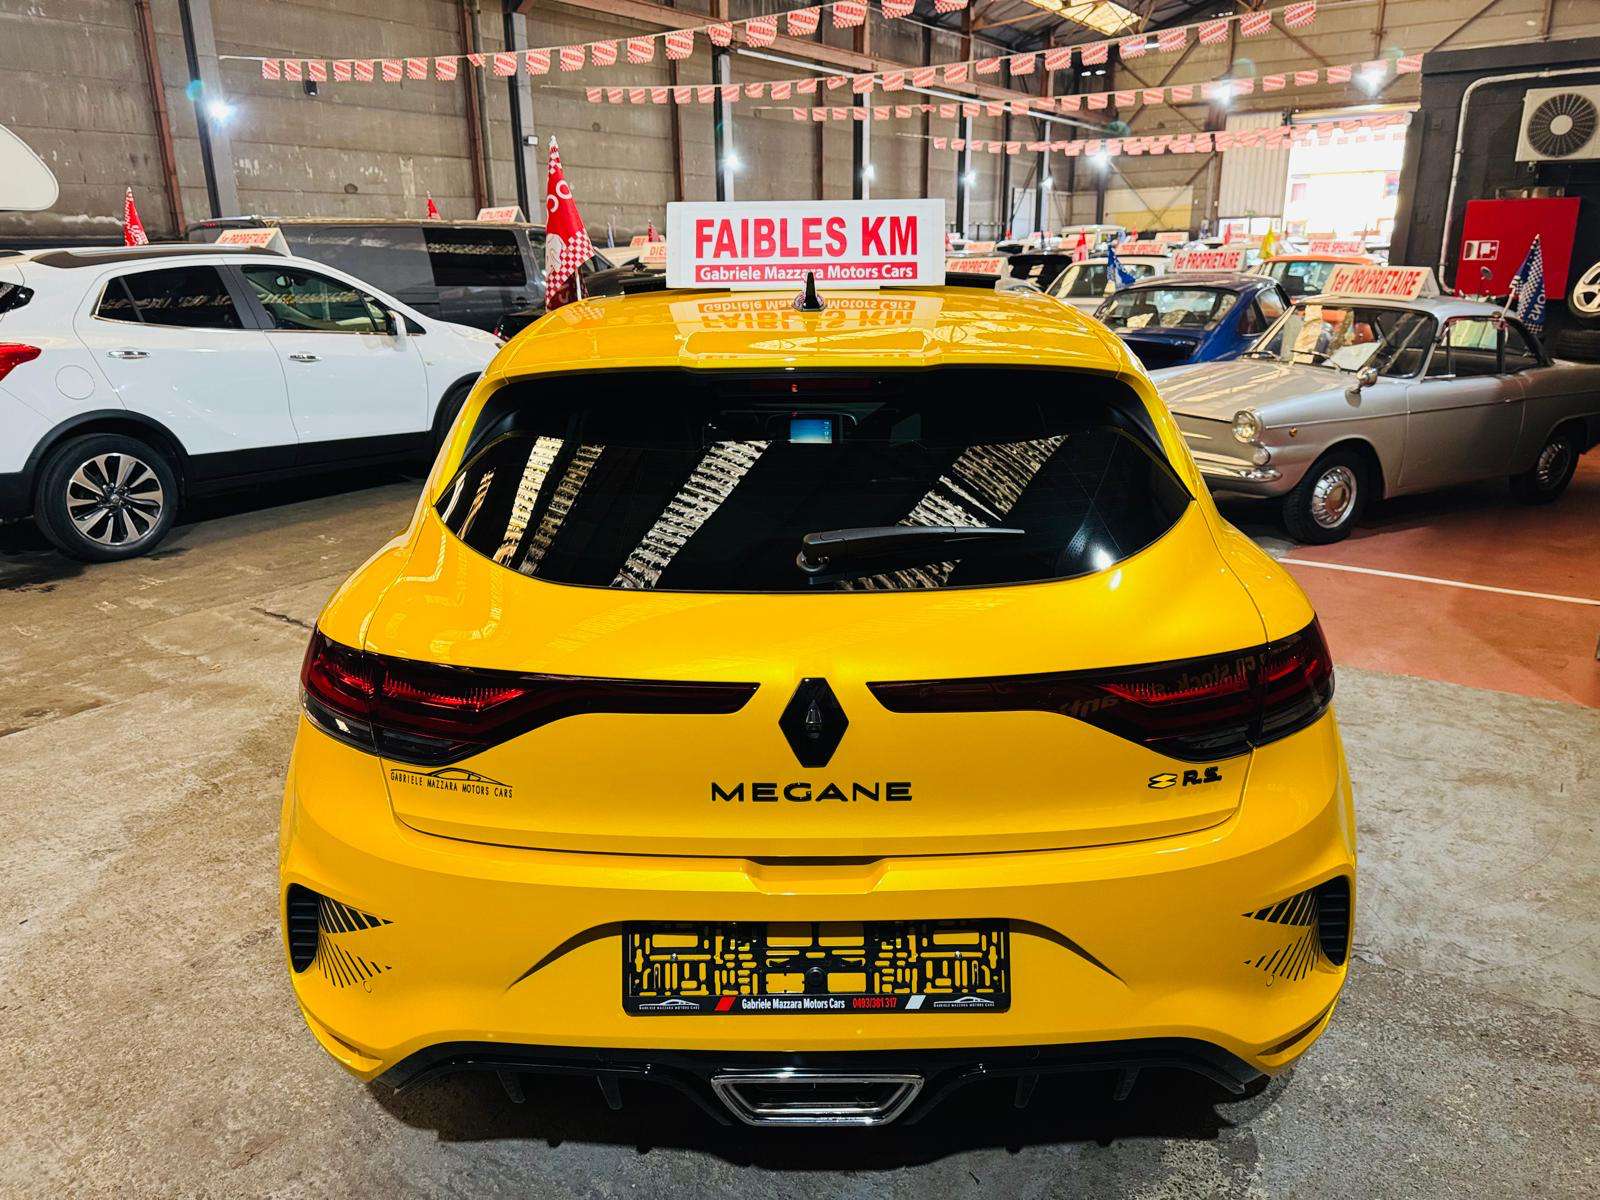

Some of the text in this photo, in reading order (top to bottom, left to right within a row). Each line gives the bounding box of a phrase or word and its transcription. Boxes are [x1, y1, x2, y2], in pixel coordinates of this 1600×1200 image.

[695, 216, 918, 259] FAIBLES KM
[700, 266, 760, 281] Gabriele
[827, 264, 878, 279] Motors
[883, 264, 913, 279] Cars
[390, 772, 513, 798] GABRIELE MAZZARA MOTORS CARS
[711, 782, 913, 802] MEGANE
[742, 999, 772, 1009] Gabriele
[773, 999, 802, 1009] Mazzara
[803, 998, 829, 1009] Motors
[829, 998, 845, 1009] Cars
